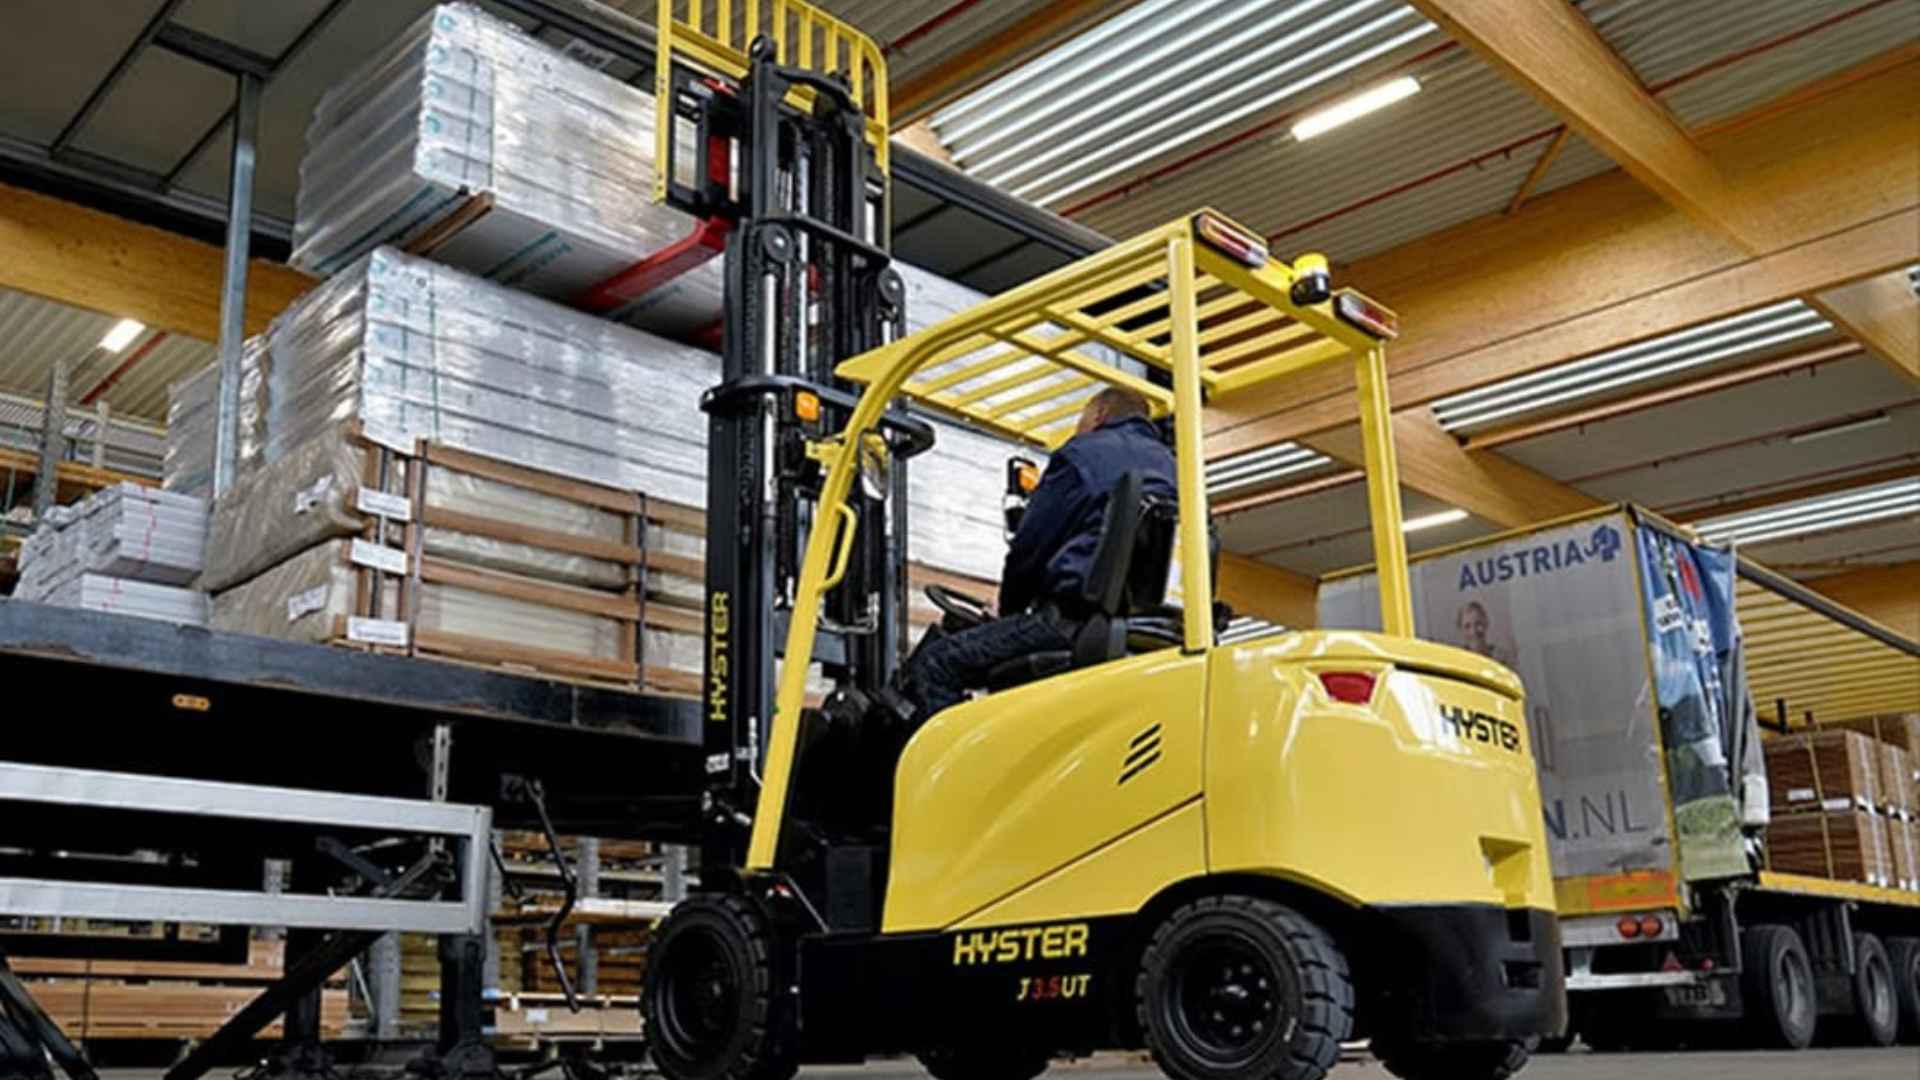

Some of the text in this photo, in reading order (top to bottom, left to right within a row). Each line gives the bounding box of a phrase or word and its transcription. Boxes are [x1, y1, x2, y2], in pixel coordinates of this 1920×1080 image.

[1459, 540, 1585, 591] AUSTRIA
[710, 592, 729, 720] HYSTER
[1440, 704, 1522, 755] HYSTER
[953, 923, 1089, 966] HYSTER
